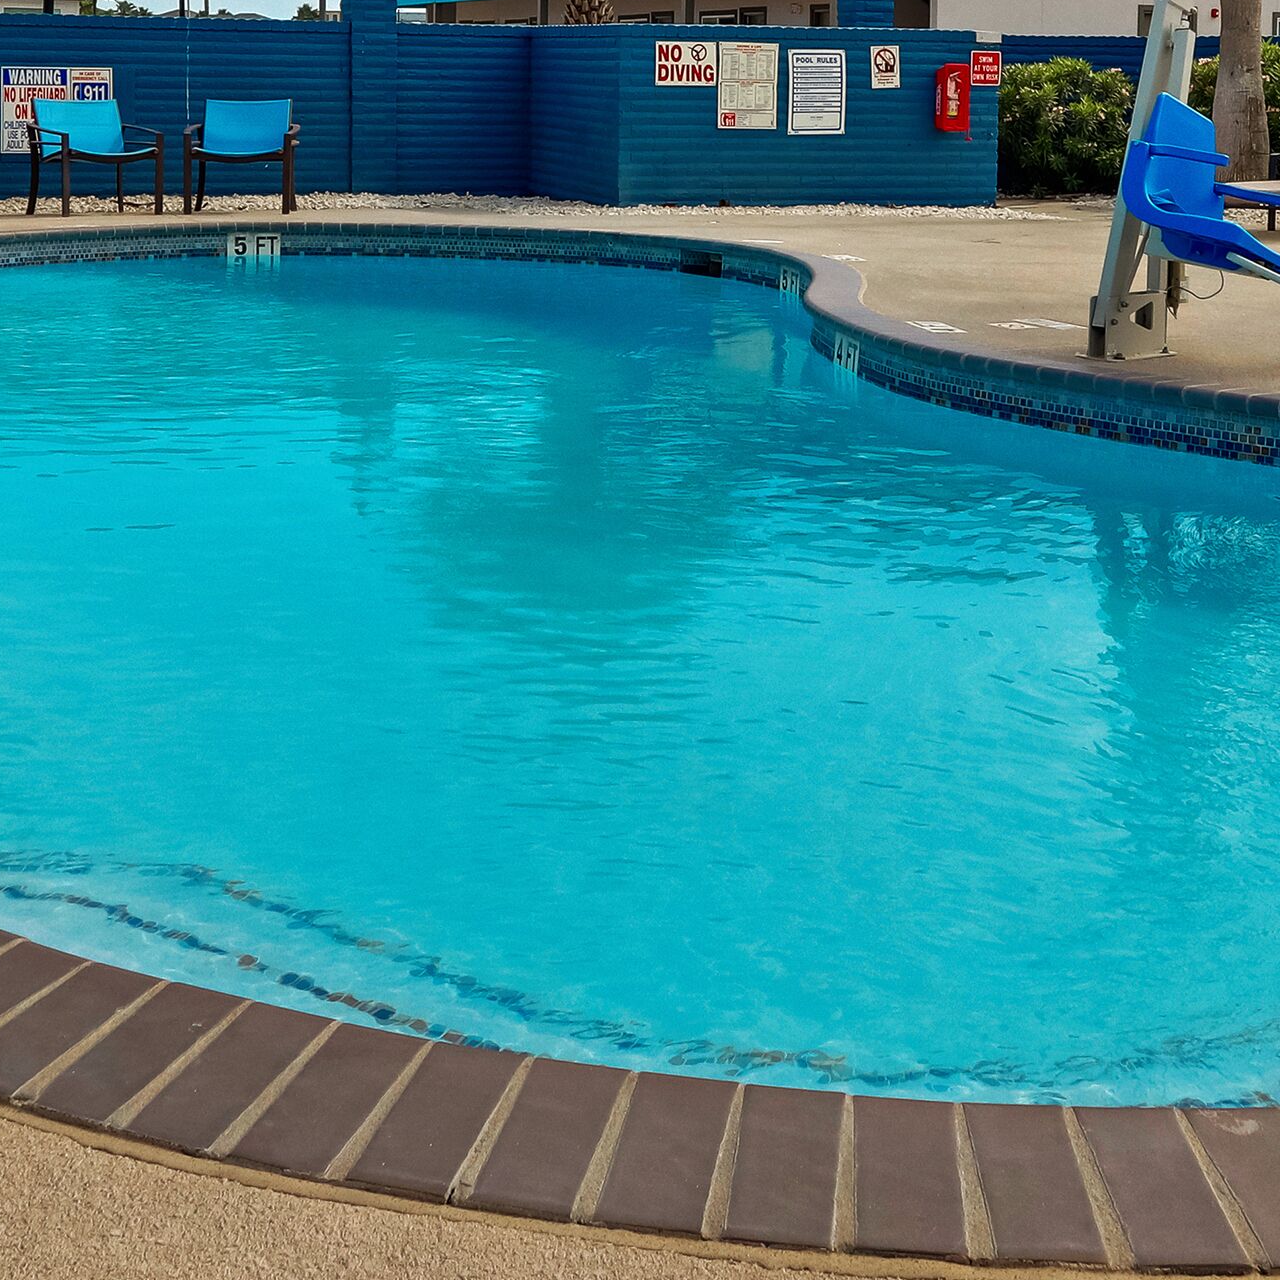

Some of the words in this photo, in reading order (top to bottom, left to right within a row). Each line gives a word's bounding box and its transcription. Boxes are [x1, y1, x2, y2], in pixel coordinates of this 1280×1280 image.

[658, 44, 682, 62] NO
[8, 69, 61, 84] WARNING
[658, 64, 714, 82] DIVING
[4, 87, 16, 102] NO
[19, 87, 66, 102] LIFEGUARD
[84, 85, 105, 100] 911
[15, 104, 28, 119] ON
[4, 121, 28, 129] CHILDRE
[8, 131, 18, 139] USE
[7, 140, 24, 149] ADULT
[234, 236, 247, 255] 5
[255, 236, 278, 255] FT
[782, 269, 788, 290] 5
[790, 271, 799, 294] FT
[836, 337, 843, 366] 4
[846, 341, 858, 373] FT
